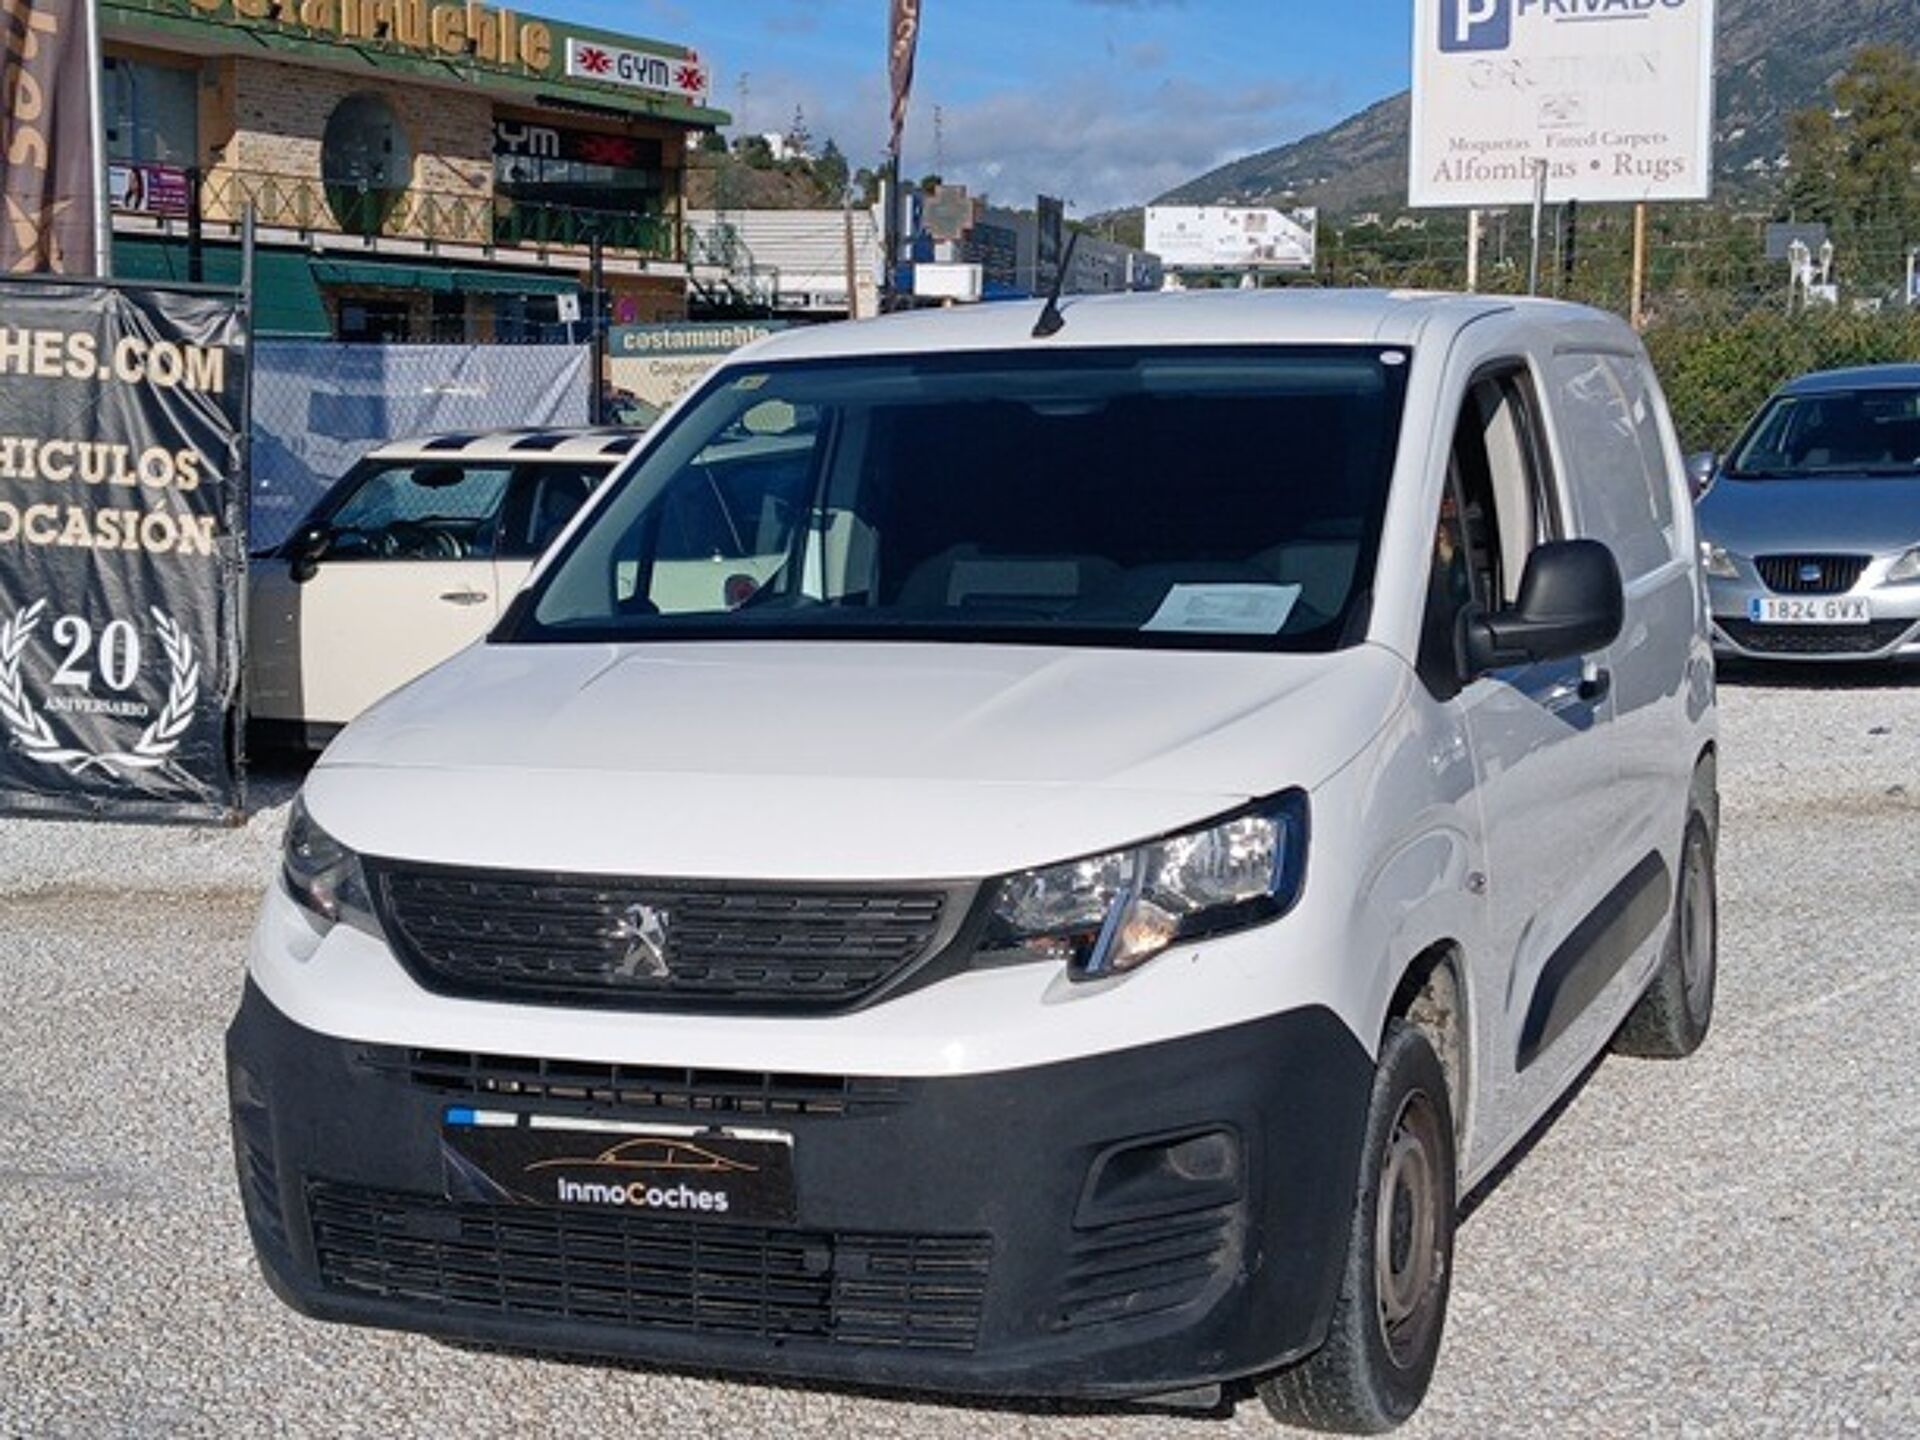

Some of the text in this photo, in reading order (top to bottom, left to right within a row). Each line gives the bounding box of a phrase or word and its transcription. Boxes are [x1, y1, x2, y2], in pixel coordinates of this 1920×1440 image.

[190, 0, 551, 70] amueble
[1454, 0, 1496, 42] P
[617, 53, 669, 88] GYM
[1600, 130, 1668, 149] Carpets
[1432, 151, 1686, 183] Alfombas Rugs
[0, 328, 225, 393] HES.COM
[1767, 601, 1816, 619] 1824
[1824, 601, 1864, 619] GVX
[51, 615, 140, 691] 20
[557, 1177, 729, 1212] InmoCoches
